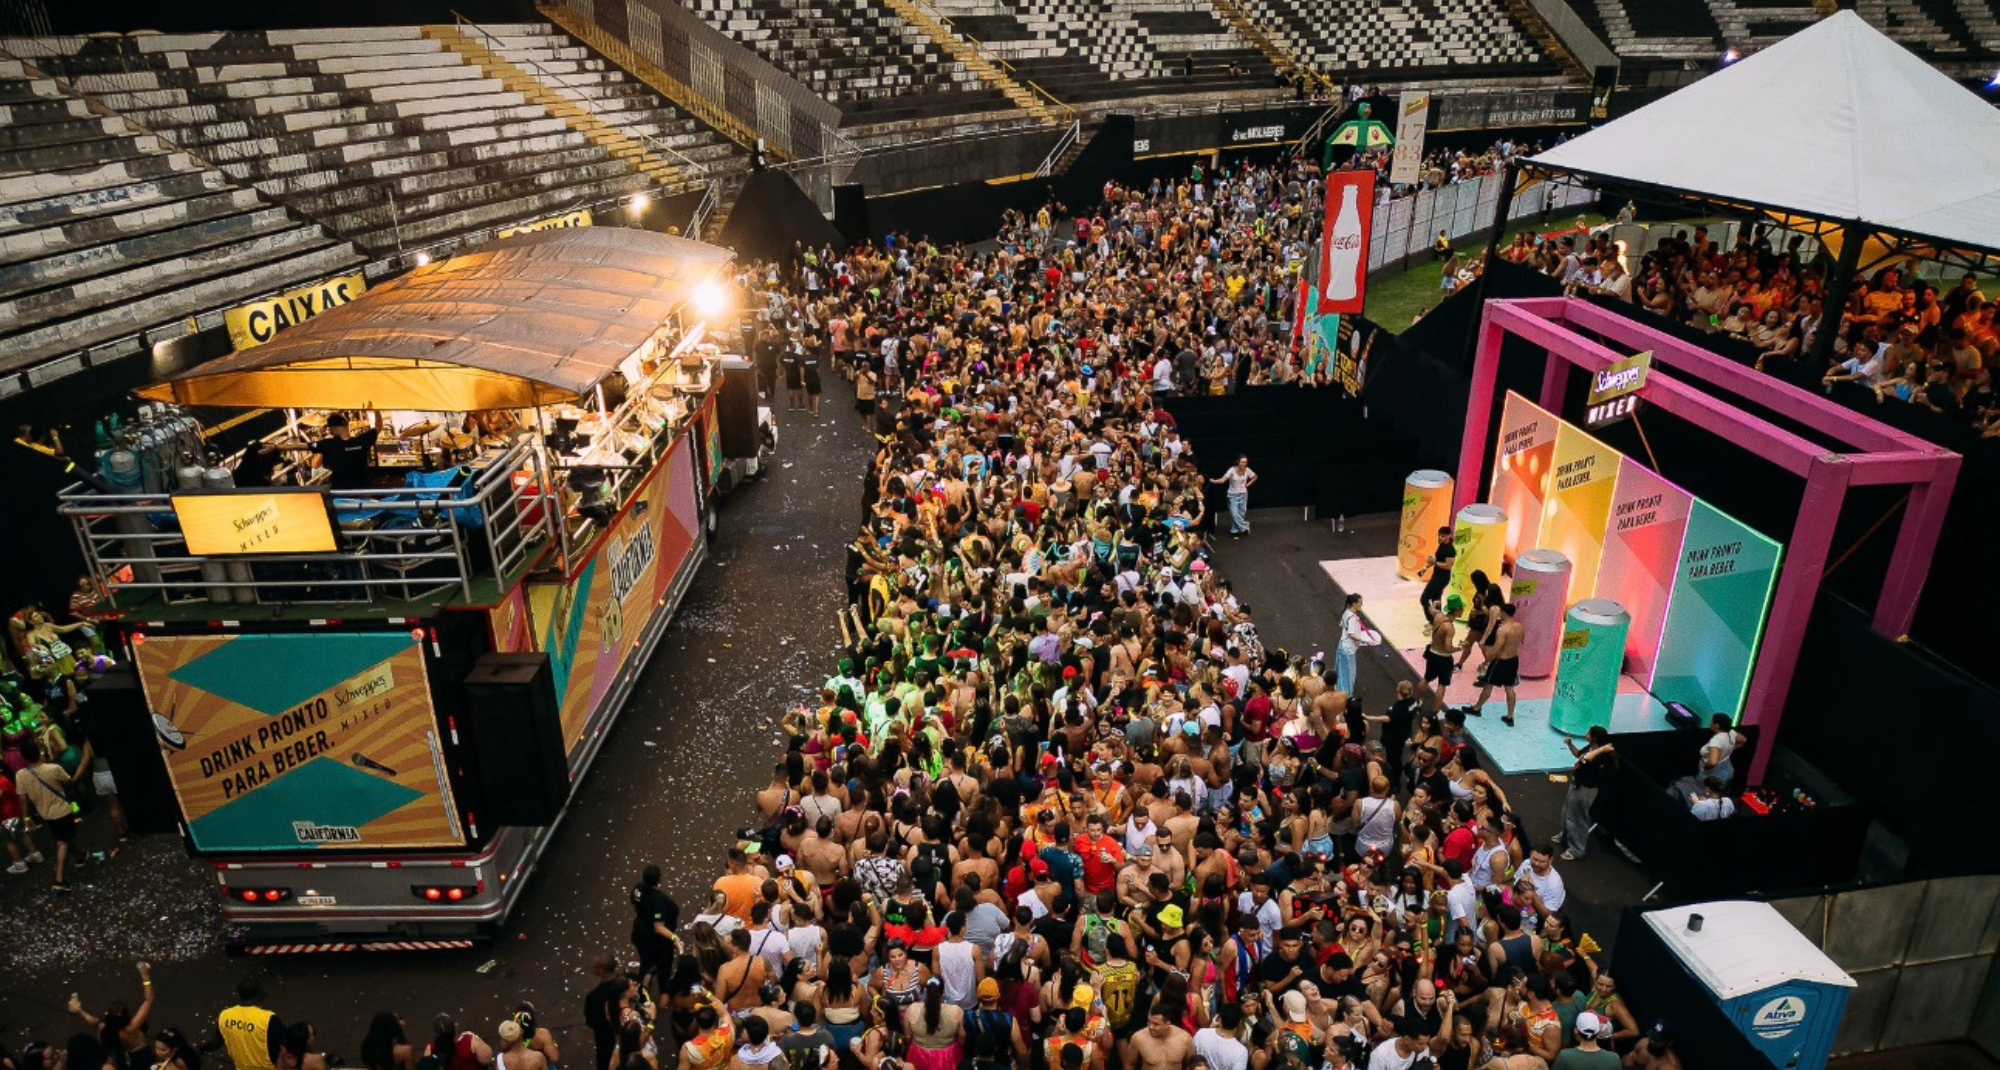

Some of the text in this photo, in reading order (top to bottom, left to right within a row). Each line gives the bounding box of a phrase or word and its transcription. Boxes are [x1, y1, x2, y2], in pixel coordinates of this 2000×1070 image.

[249, 282, 352, 343] CAIXAS
[1686, 541, 1742, 564] DRINK PRONTO
[1688, 564, 1709, 579] PARA
[334, 674, 387, 708] Schweppes
[340, 698, 392, 732] MIXED
[201, 697, 329, 779] DRINK PRONTO
[221, 730, 336, 799] PARA BEBER.
[298, 827, 359, 840] CALIFORNIA
[1764, 1010, 1797, 1020] Ativa
